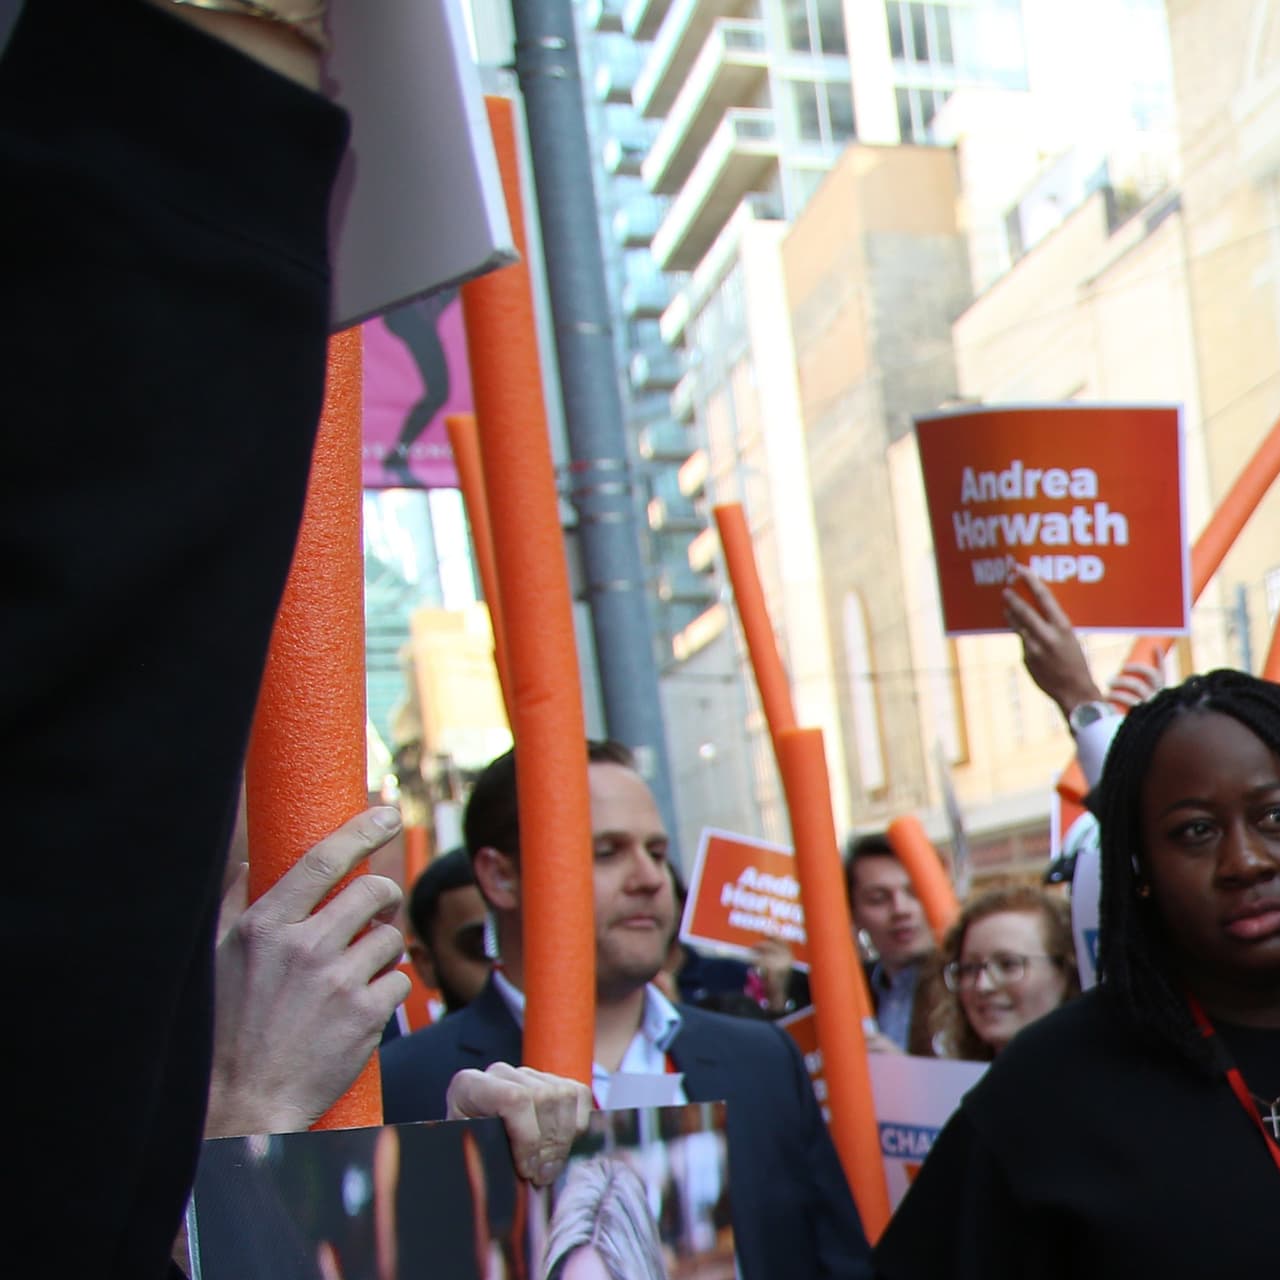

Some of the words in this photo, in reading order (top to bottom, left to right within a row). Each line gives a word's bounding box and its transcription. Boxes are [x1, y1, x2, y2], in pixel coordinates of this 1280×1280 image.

[960, 459, 1099, 505] Andrea
[952, 502, 1129, 552] Horwath
[1029, 554, 1105, 584] NPD
[881, 1127, 938, 1155] CHA
